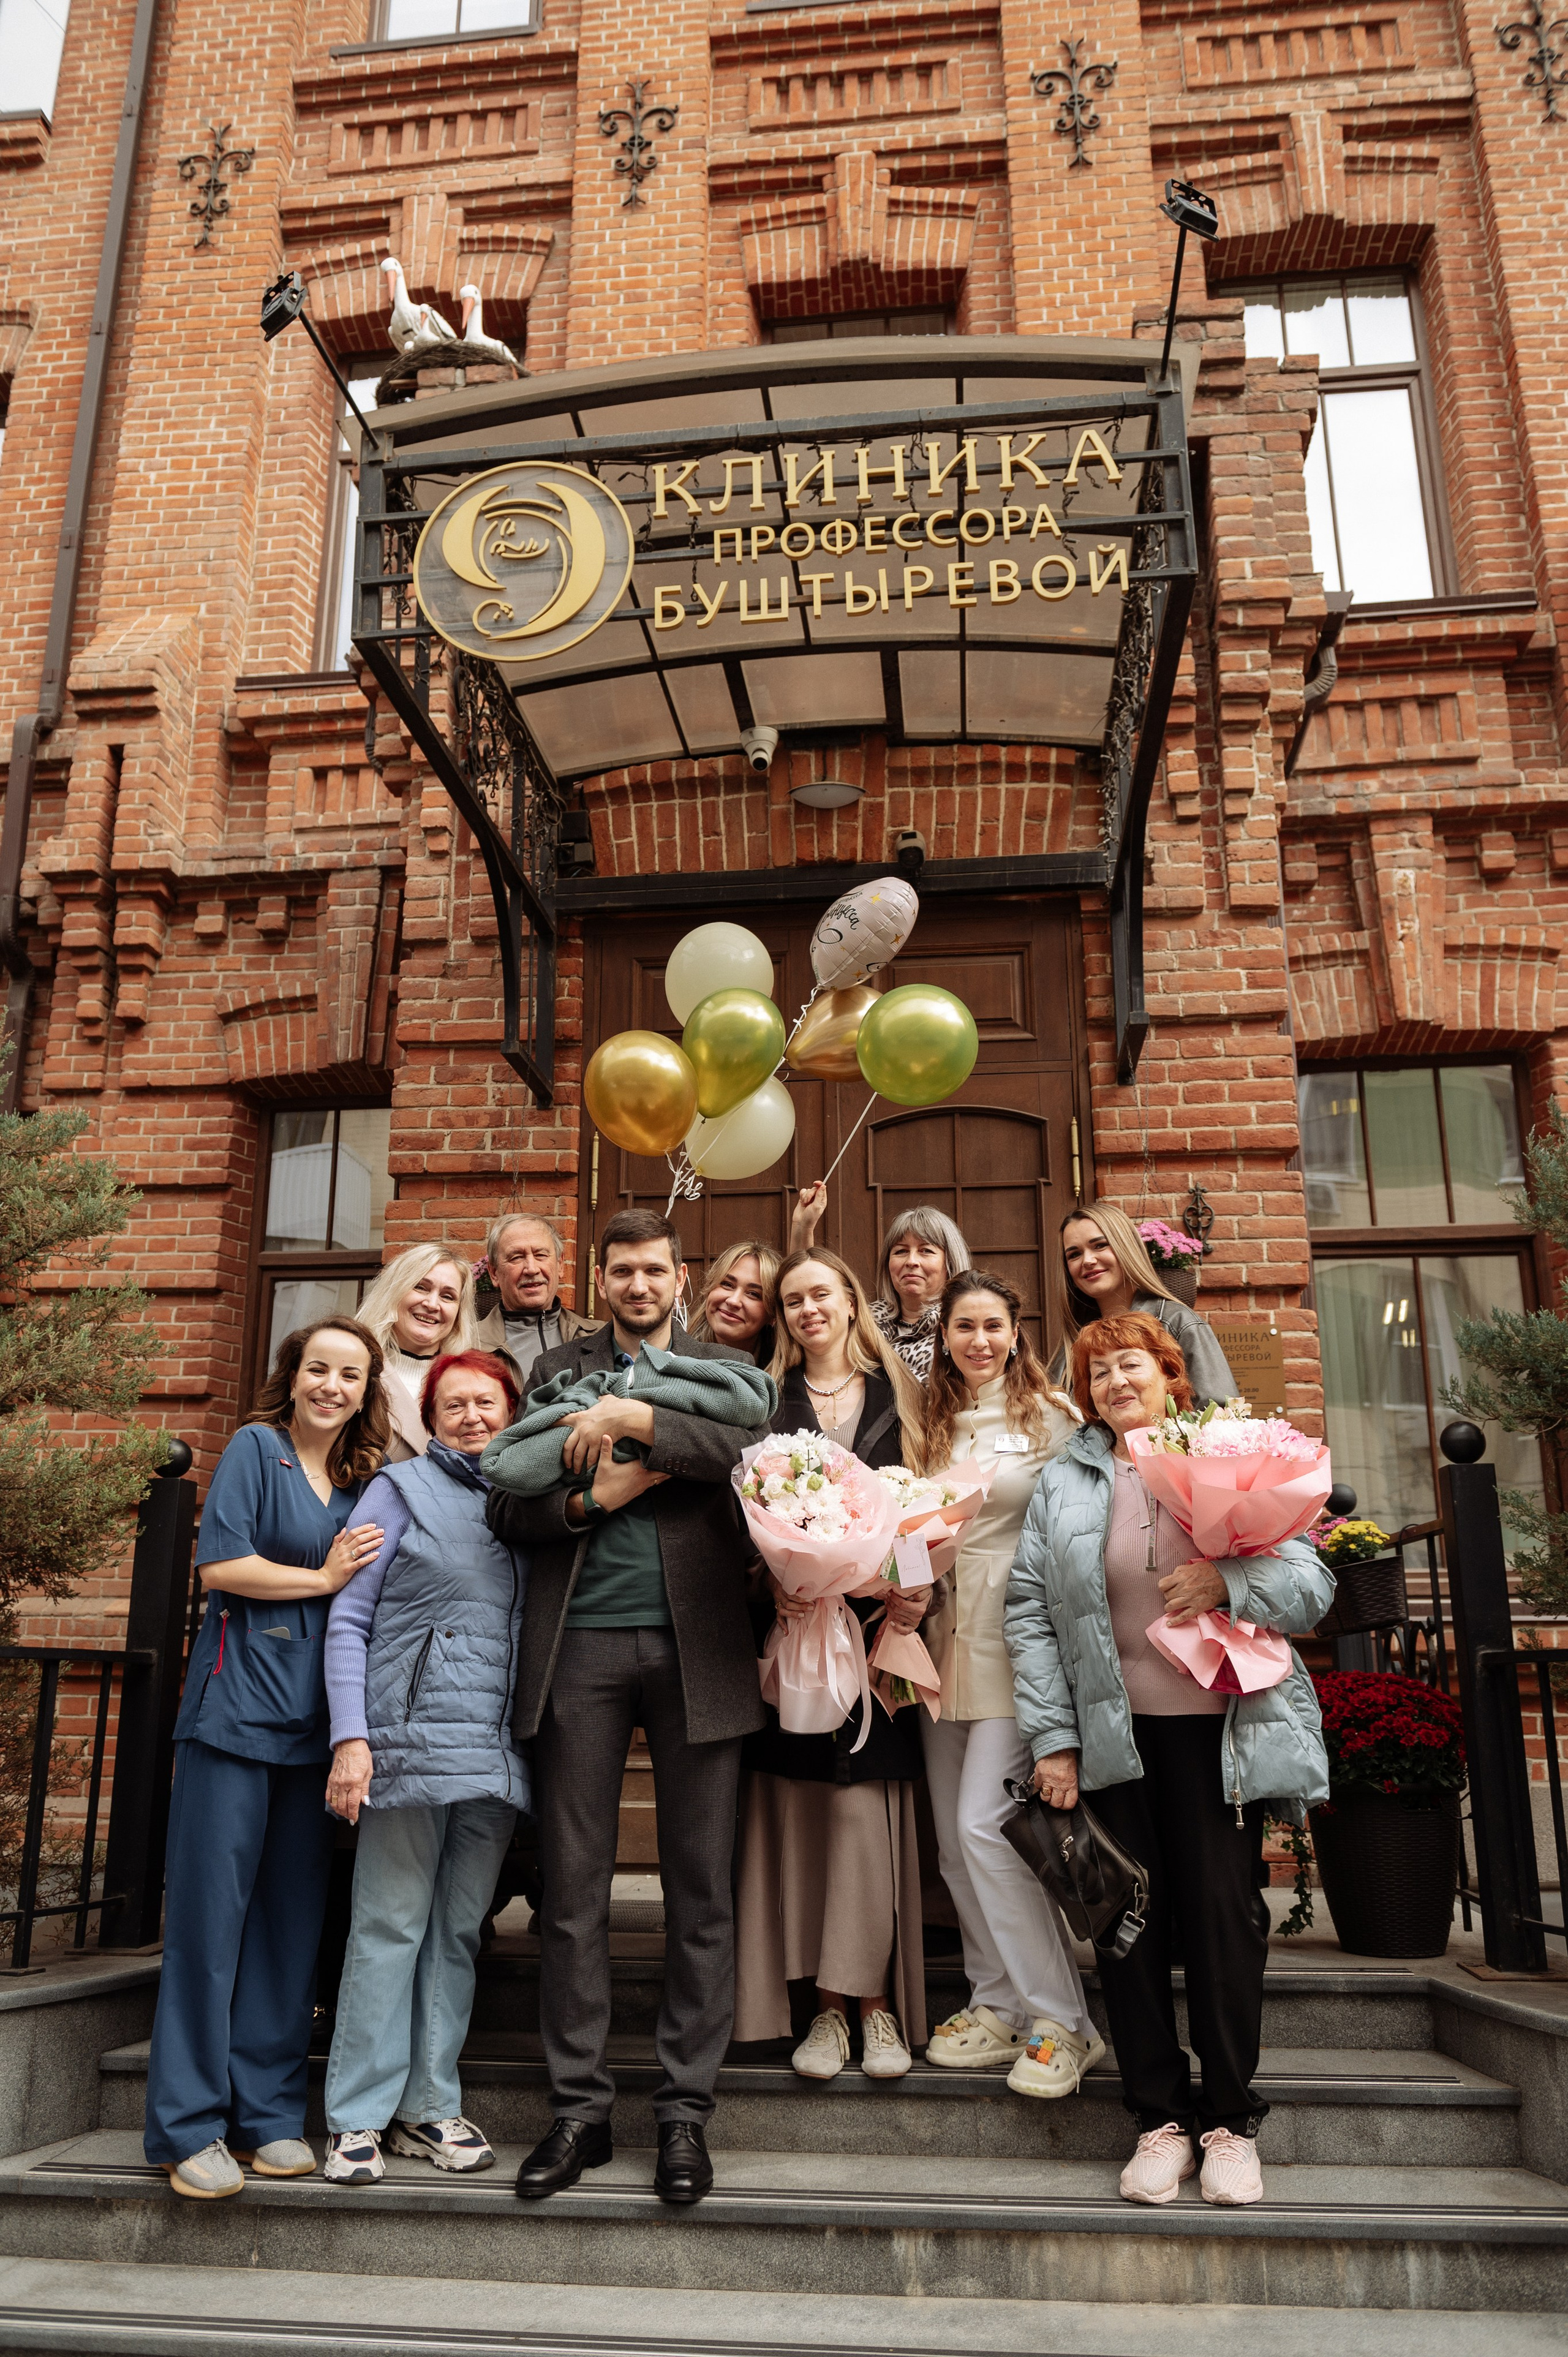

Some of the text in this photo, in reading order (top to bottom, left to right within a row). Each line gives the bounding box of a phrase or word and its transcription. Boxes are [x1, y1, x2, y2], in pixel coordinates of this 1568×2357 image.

[652, 429, 1122, 518] КЛИНИКА
[713, 503, 1061, 565] ПРОФЕССОРА
[654, 543, 1129, 630] БУШТЫРЕВОЙ
[1216, 1332, 1270, 1343] ИНИКА
[1227, 1352, 1272, 1362] ЫРЕВОЙ
